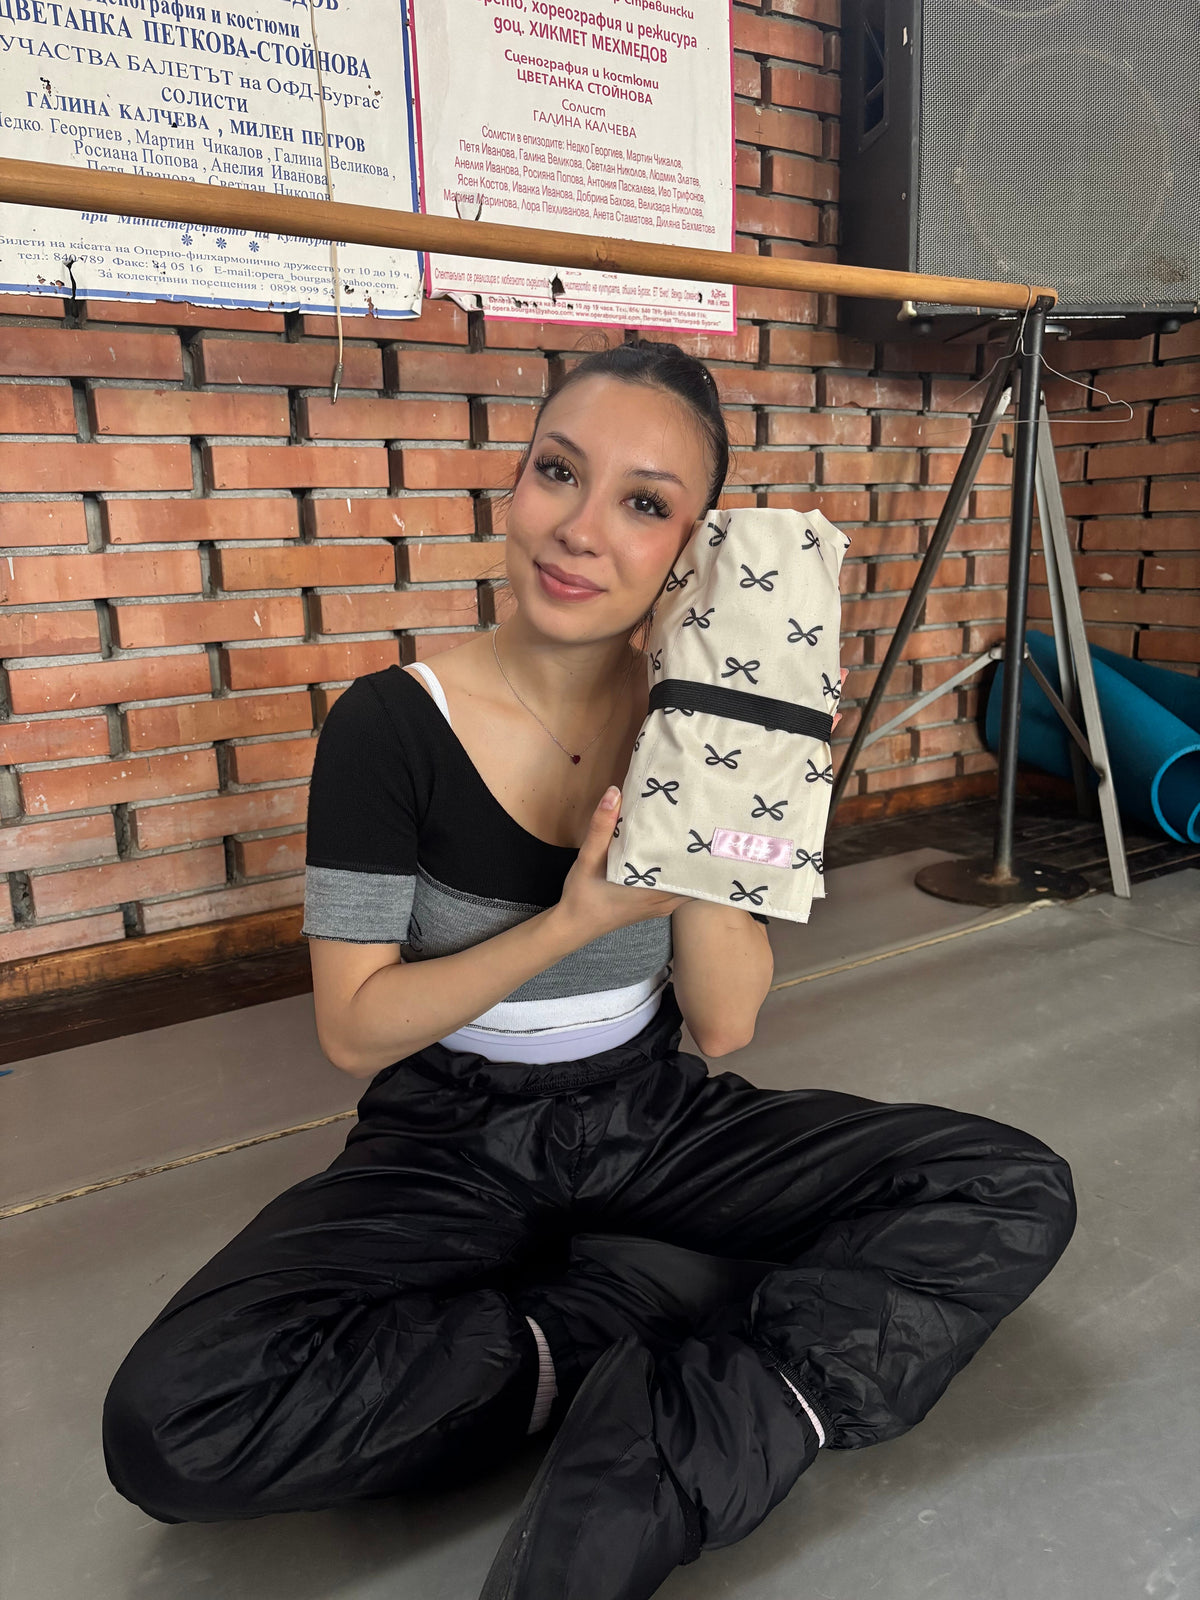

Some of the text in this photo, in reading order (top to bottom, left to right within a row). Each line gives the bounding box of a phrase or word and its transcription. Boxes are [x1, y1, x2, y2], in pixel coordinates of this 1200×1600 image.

[0, 0, 372, 79] ЦВЕТАНКА ПЕТКОВА-СТОЙНОВА
[211, 9, 221, 24] и
[227, 12, 300, 38] костюми
[494, 16, 668, 64] доц. ХИКМЕТ МЕХМЕДОВ
[532, 0, 622, 32] хореография
[625, 23, 634, 34] и
[637, 22, 698, 49] режисура
[0, 35, 381, 110] УЧАСТВА БАЛЕТЪТ на ОФД-Бургас
[504, 49, 659, 90] Сценография и костюми
[517, 68, 653, 105] ЦВЕТАНКА СТОЙНОВА
[161, 86, 249, 114] СОЛИСТИ
[561, 99, 606, 117] Солист
[26, 91, 110, 117] ГАЛИНА
[119, 104, 209, 130] КАЛЧЕВА
[229, 119, 295, 142] МИЛЕН
[302, 130, 366, 152] ПЕТРОВ
[533, 110, 637, 138] ГАЛИНА КАЛЧЕВА
[50, 118, 123, 141] Георгиев
[136, 129, 195, 151] Мартин
[203, 137, 263, 159] Чикалов
[274, 147, 323, 168] Галина
[329, 155, 389, 177] Великова
[74, 140, 138, 162] Росиана
[142, 149, 198, 170] Попова
[211, 157, 264, 178] Анелия
[272, 165, 329, 186] Иванова
[459, 139, 480, 153] Петя
[482, 143, 517, 160] Иванова,
[519, 148, 546, 163] Галина
[586, 159, 616, 174] Светлан
[481, 125, 516, 142] Солисти
[523, 134, 565, 150] епизодите:
[566, 139, 589, 154] Недко
[626, 149, 653, 165] Мартин
[454, 156, 484, 171] Анелия
[486, 160, 521, 177] Иванова,
[587, 175, 617, 190] Антония
[457, 173, 479, 187] Ясен
[480, 176, 511, 193] Костов,
[512, 181, 540, 196] Иванка
[81, 212, 108, 224] при
[521, 198, 540, 213] Лора
[593, 207, 615, 220] Анета
[0, 236, 45, 248] Билети
[70, 242, 111, 252] касата
[116, 246, 130, 254] на
[134, 246, 281, 268] Оперно-филхармонично
[359, 267, 371, 275] 10
[389, 270, 401, 278] 19
[112, 257, 148, 268] Факс:
[171, 262, 185, 271] 05
[190, 264, 203, 272] 16
[98, 269, 113, 279] За
[117, 272, 188, 285] колективни
[192, 278, 257, 291] посещения
[270, 283, 297, 293] 0898
[300, 285, 319, 295] 999
